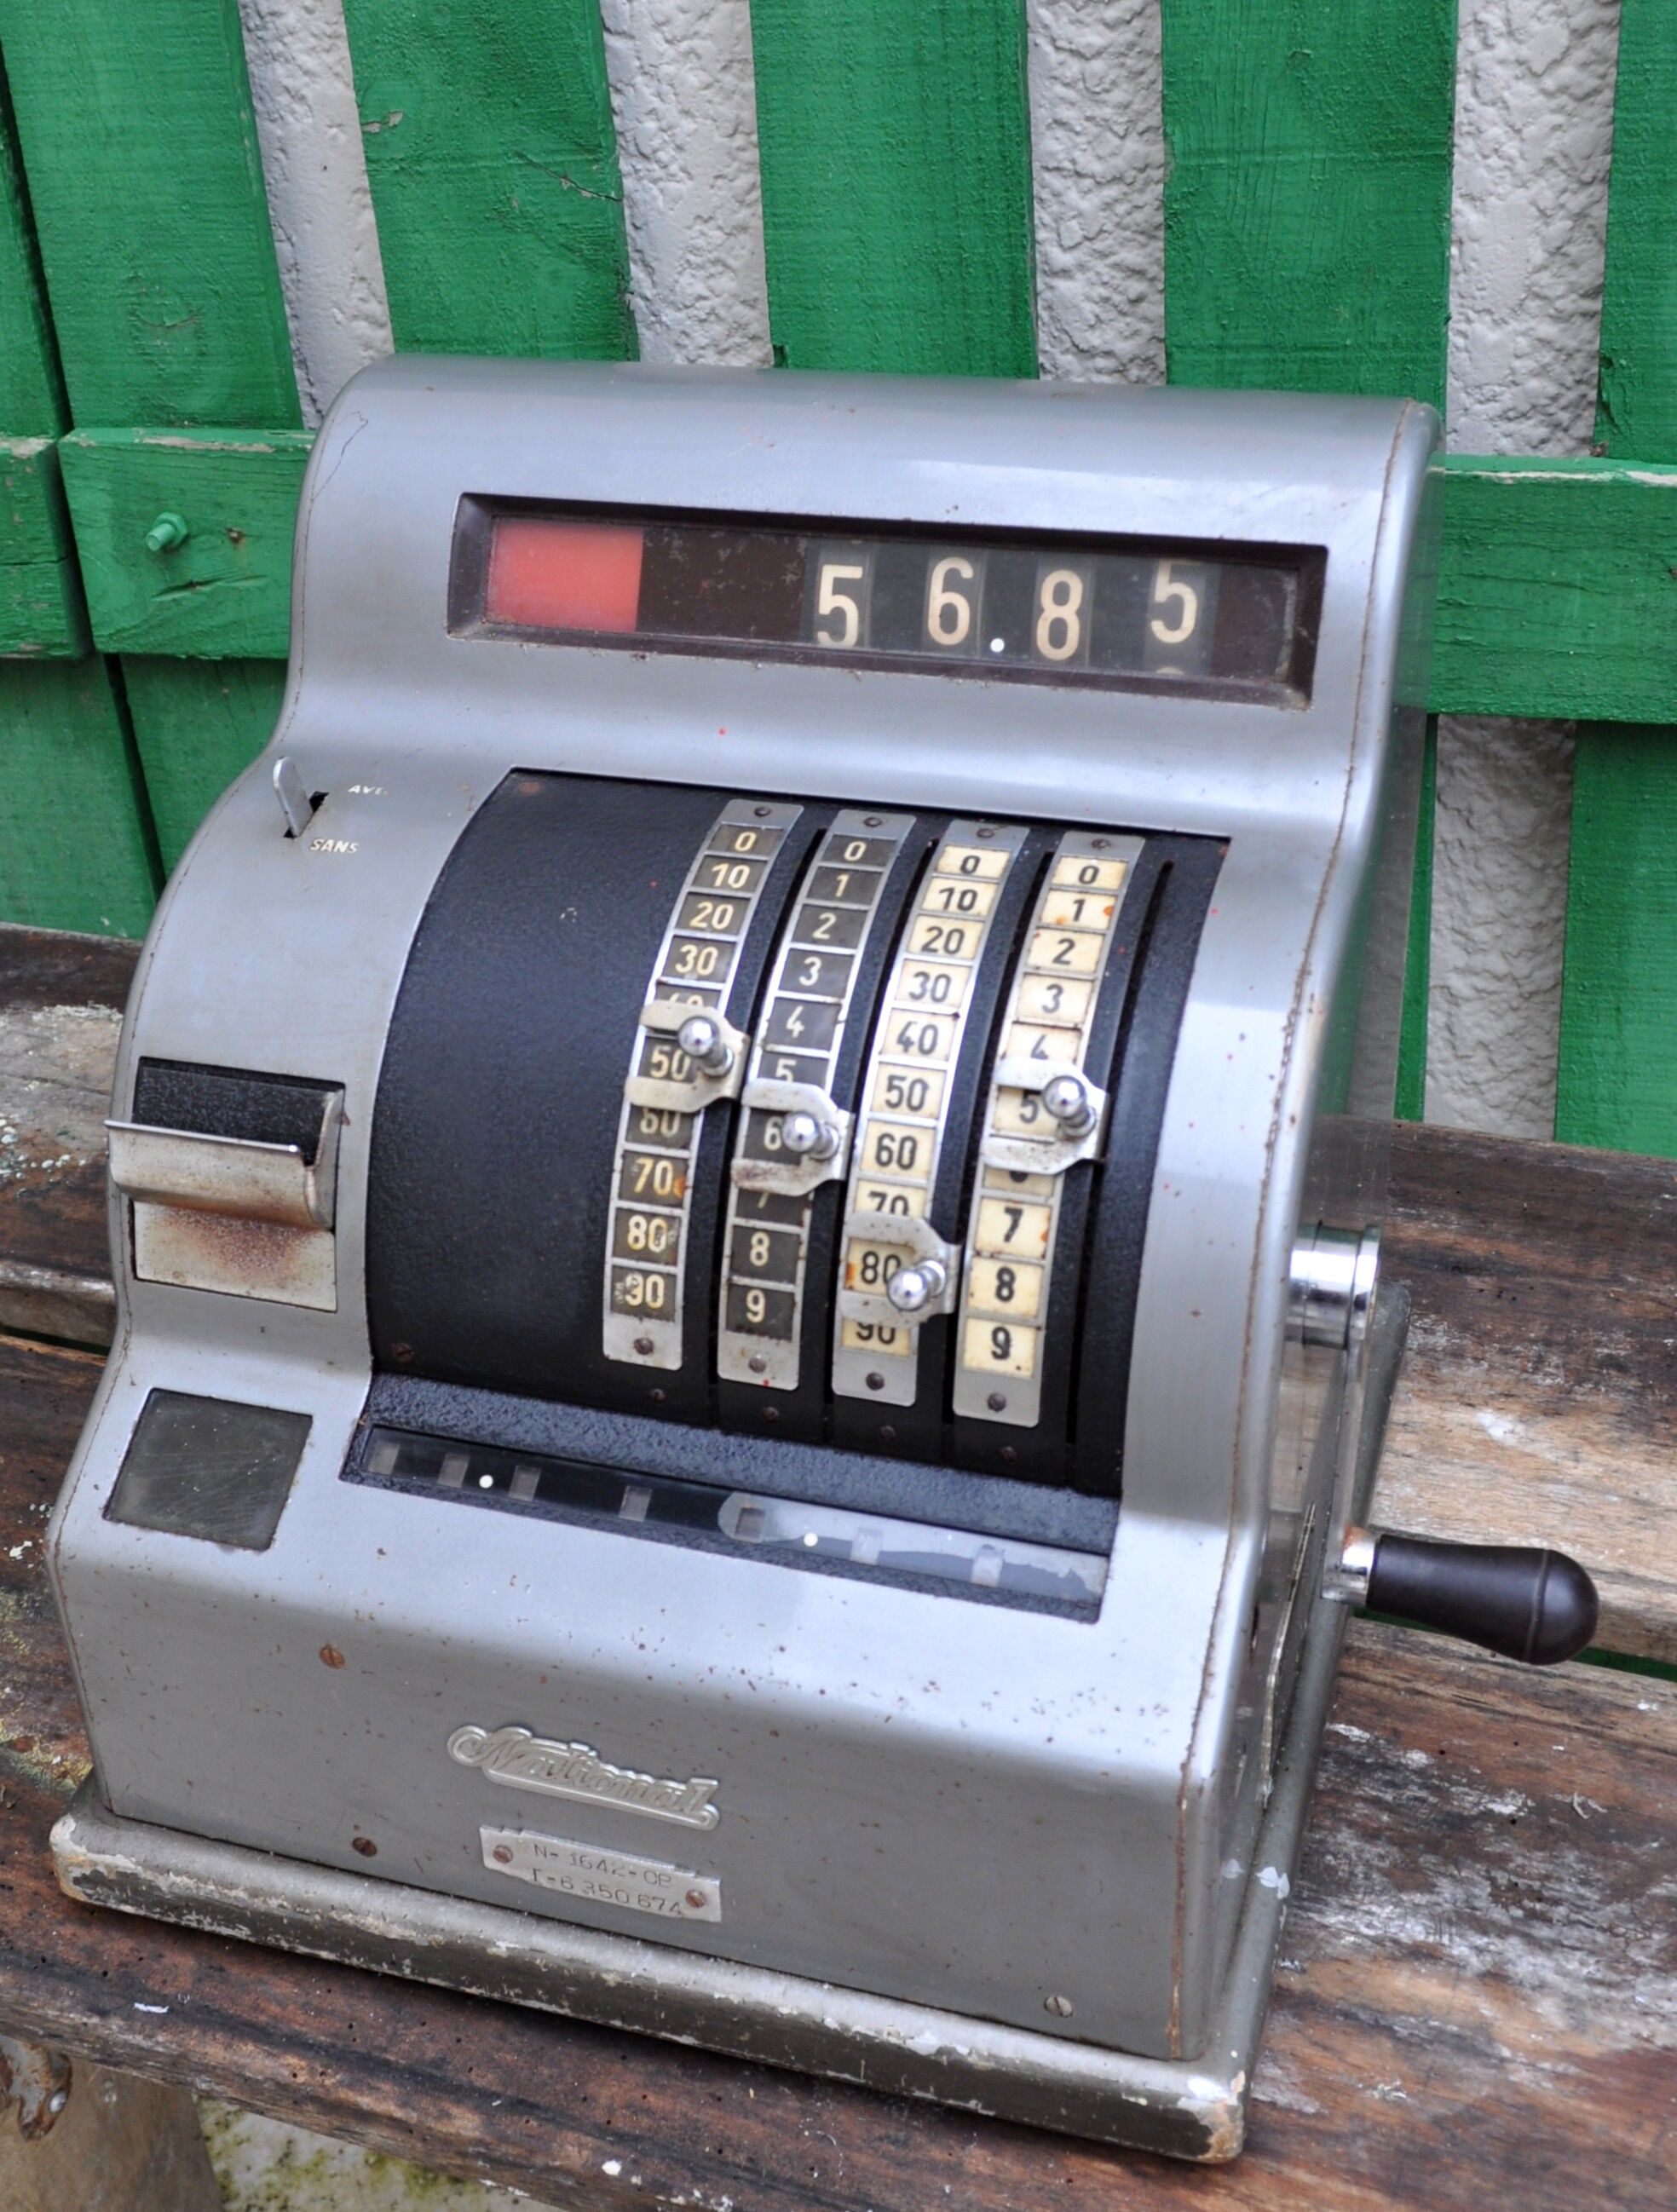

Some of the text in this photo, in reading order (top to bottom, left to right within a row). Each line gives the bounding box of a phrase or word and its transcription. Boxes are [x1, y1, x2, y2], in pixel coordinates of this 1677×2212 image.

[310, 838, 359, 853] SANS
[735, 832, 1099, 884] 0 0 0 0
[712, 862, 1086, 921] 10 1 10 1
[689, 902, 1075, 965] 20 2 20 2
[674, 944, 1063, 1012] 30 3 30 3
[786, 1005, 804, 1039] 4
[896, 1022, 938, 1055] 40
[885, 1076, 929, 1112] 50
[874, 1132, 916, 1170] 60
[635, 1157, 673, 1196] 70
[1003, 1207, 1025, 1243] 7
[626, 1214, 668, 1253] 80
[749, 1230, 770, 1267] 8
[996, 1266, 1017, 1303] 8
[745, 1288, 766, 1324] 9
[991, 1327, 1012, 1360] 9
[447, 1725, 719, 1829] National
